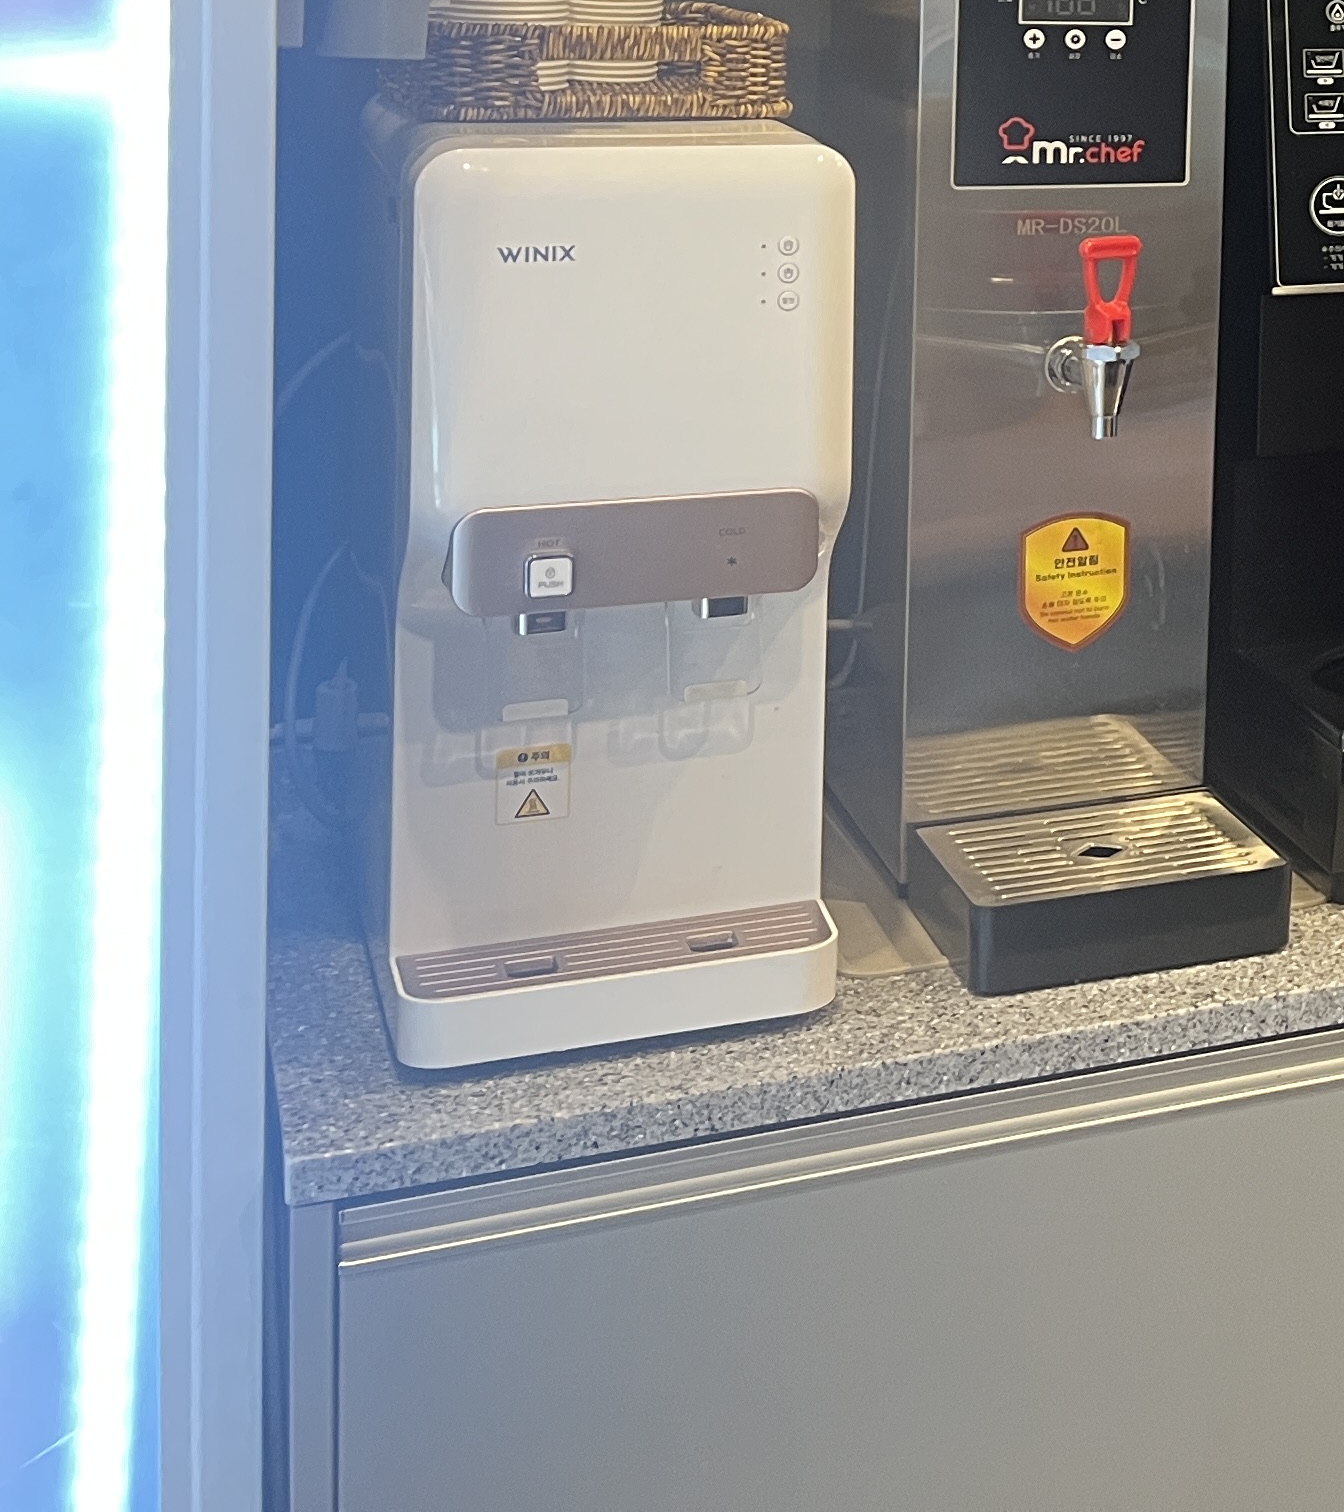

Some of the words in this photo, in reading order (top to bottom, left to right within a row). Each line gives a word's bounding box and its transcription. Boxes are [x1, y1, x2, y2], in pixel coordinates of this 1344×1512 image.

[1069, 134, 1102, 144] SINCE
[1107, 134, 1133, 144] 1997
[1017, 216, 1128, 236] MR-DS20L
[497, 244, 576, 264] WINIX
[537, 539, 562, 548] HOT
[1035, 572, 1066, 583] Safety
[1067, 568, 1117, 580] Instruction
[537, 579, 564, 589] PUSH
[530, 750, 551, 762] 주의
